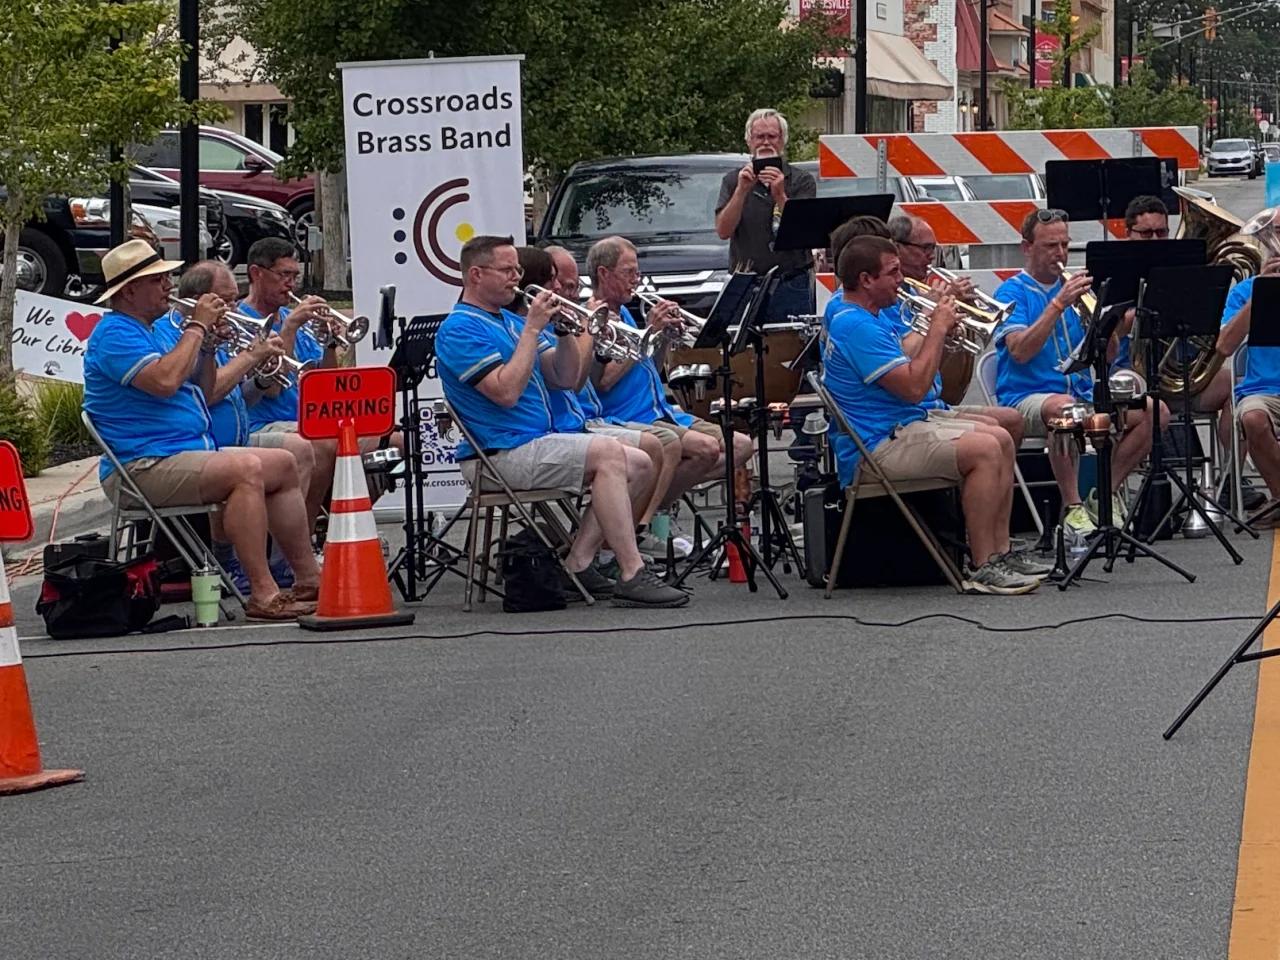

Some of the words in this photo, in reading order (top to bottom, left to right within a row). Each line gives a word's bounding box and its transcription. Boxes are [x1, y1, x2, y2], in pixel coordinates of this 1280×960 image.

[352, 85, 514, 118] Crossroads
[356, 130, 433, 155] Brass
[440, 122, 512, 150] Band
[26, 305, 55, 326] We
[12, 327, 42, 347] Our
[335, 373, 361, 393] NO
[305, 397, 390, 420] PARKING
